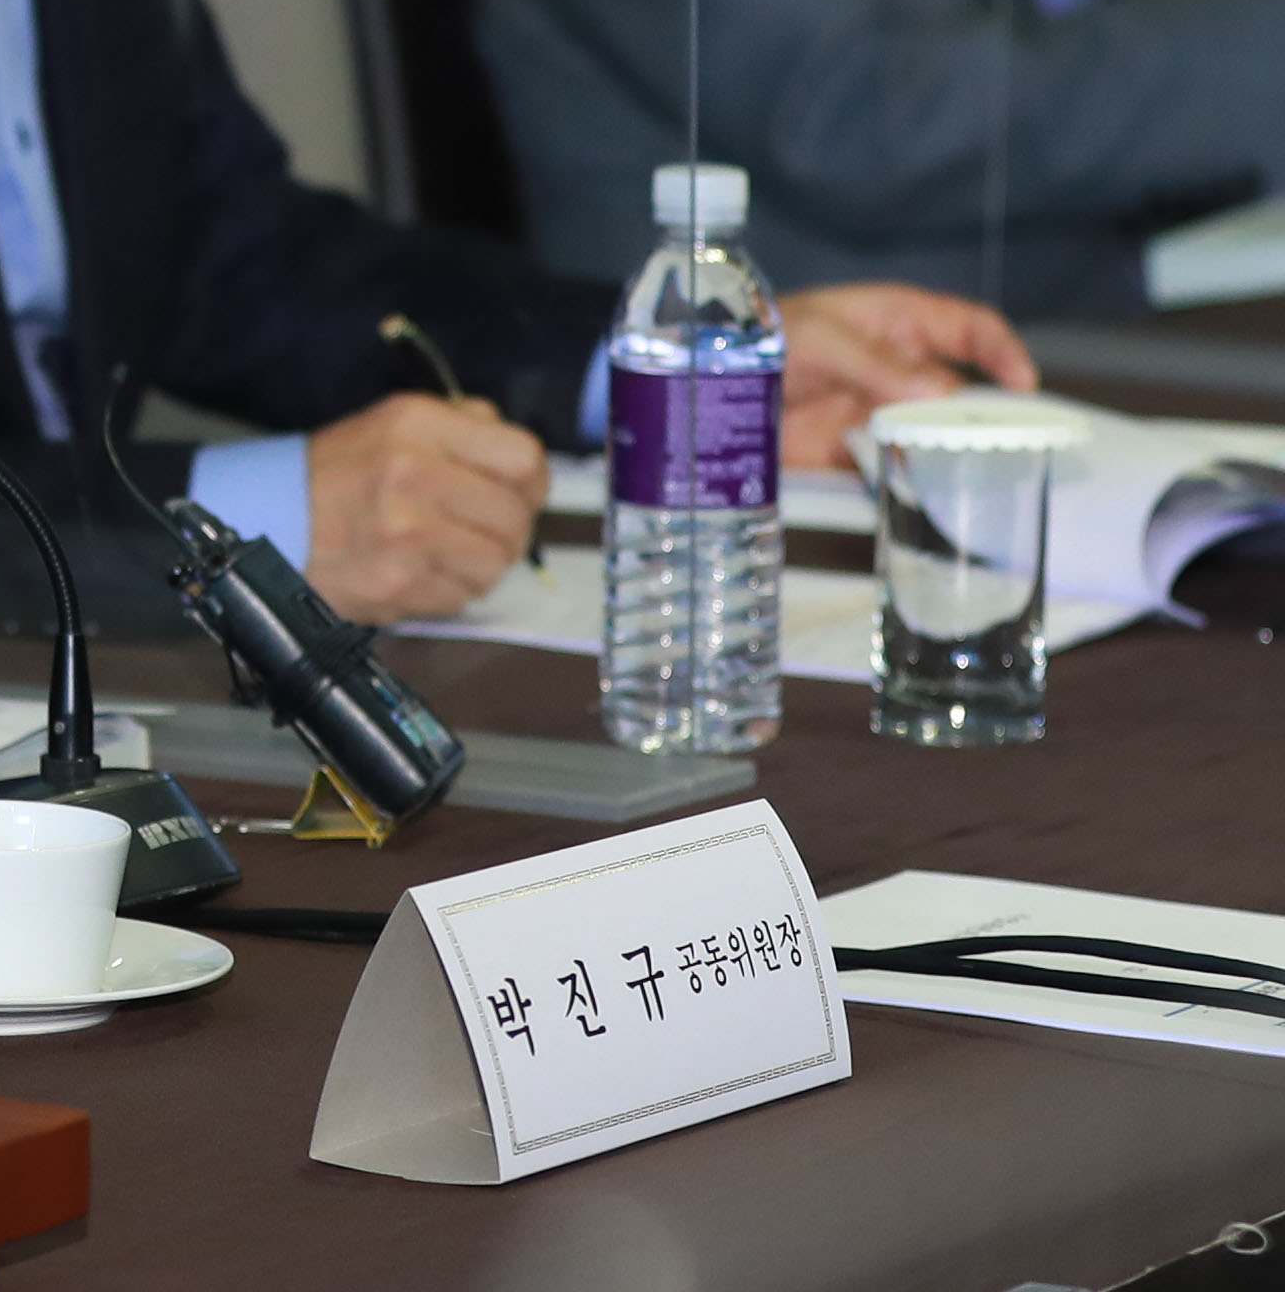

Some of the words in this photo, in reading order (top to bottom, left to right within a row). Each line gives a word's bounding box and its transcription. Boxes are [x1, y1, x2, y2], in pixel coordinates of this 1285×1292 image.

[487, 977, 535, 1056] 박
[556, 959, 607, 1038] 진
[621, 945, 665, 1022] 규
[675, 914, 802, 995] 공동위원장
